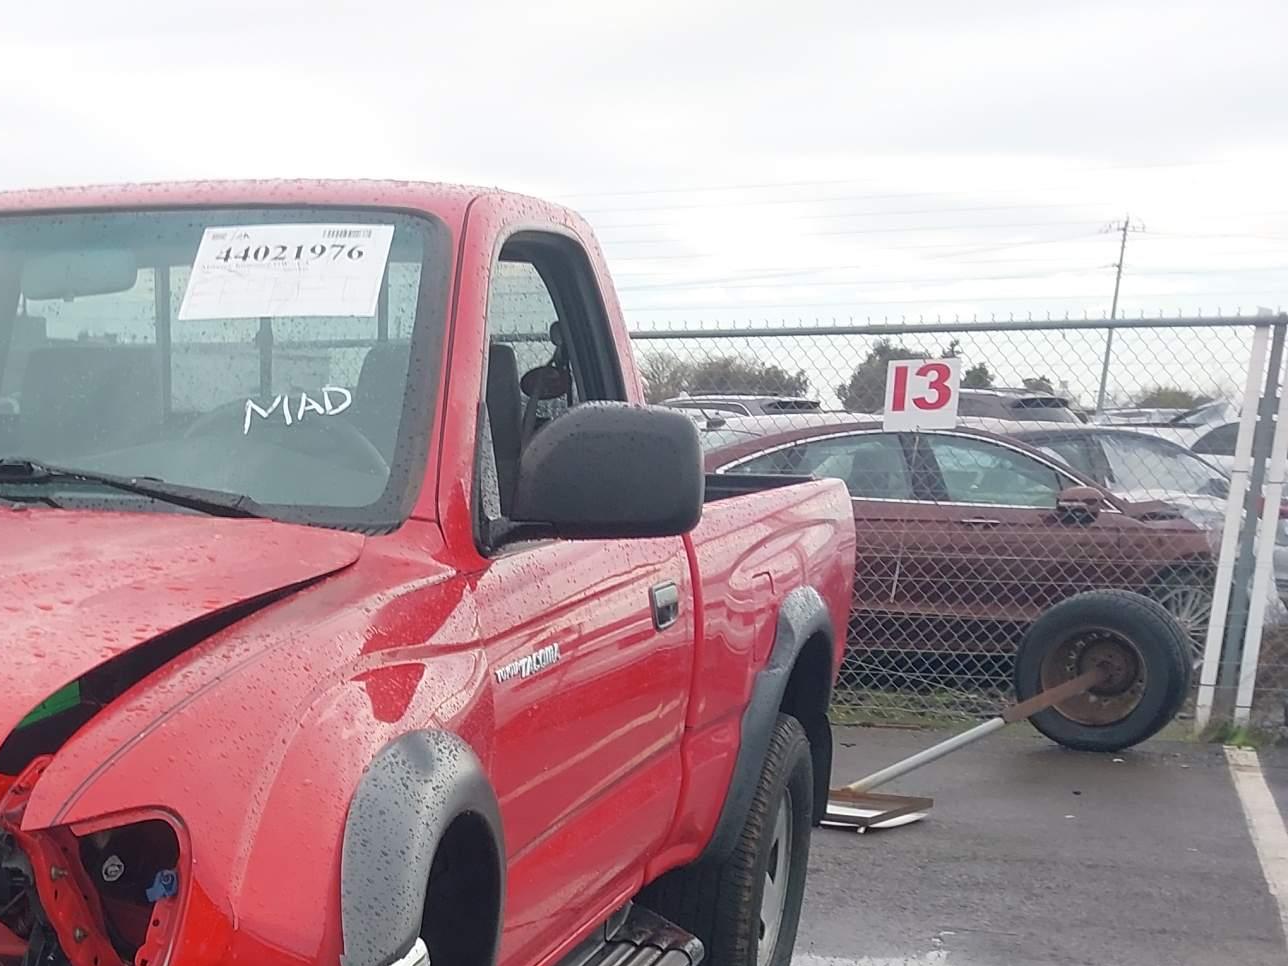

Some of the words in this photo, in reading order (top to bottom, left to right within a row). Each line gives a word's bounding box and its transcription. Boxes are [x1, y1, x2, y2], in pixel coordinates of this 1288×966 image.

[216, 244, 364, 262] 44021976
[243, 385, 352, 435] MAD
[892, 363, 952, 411] 13
